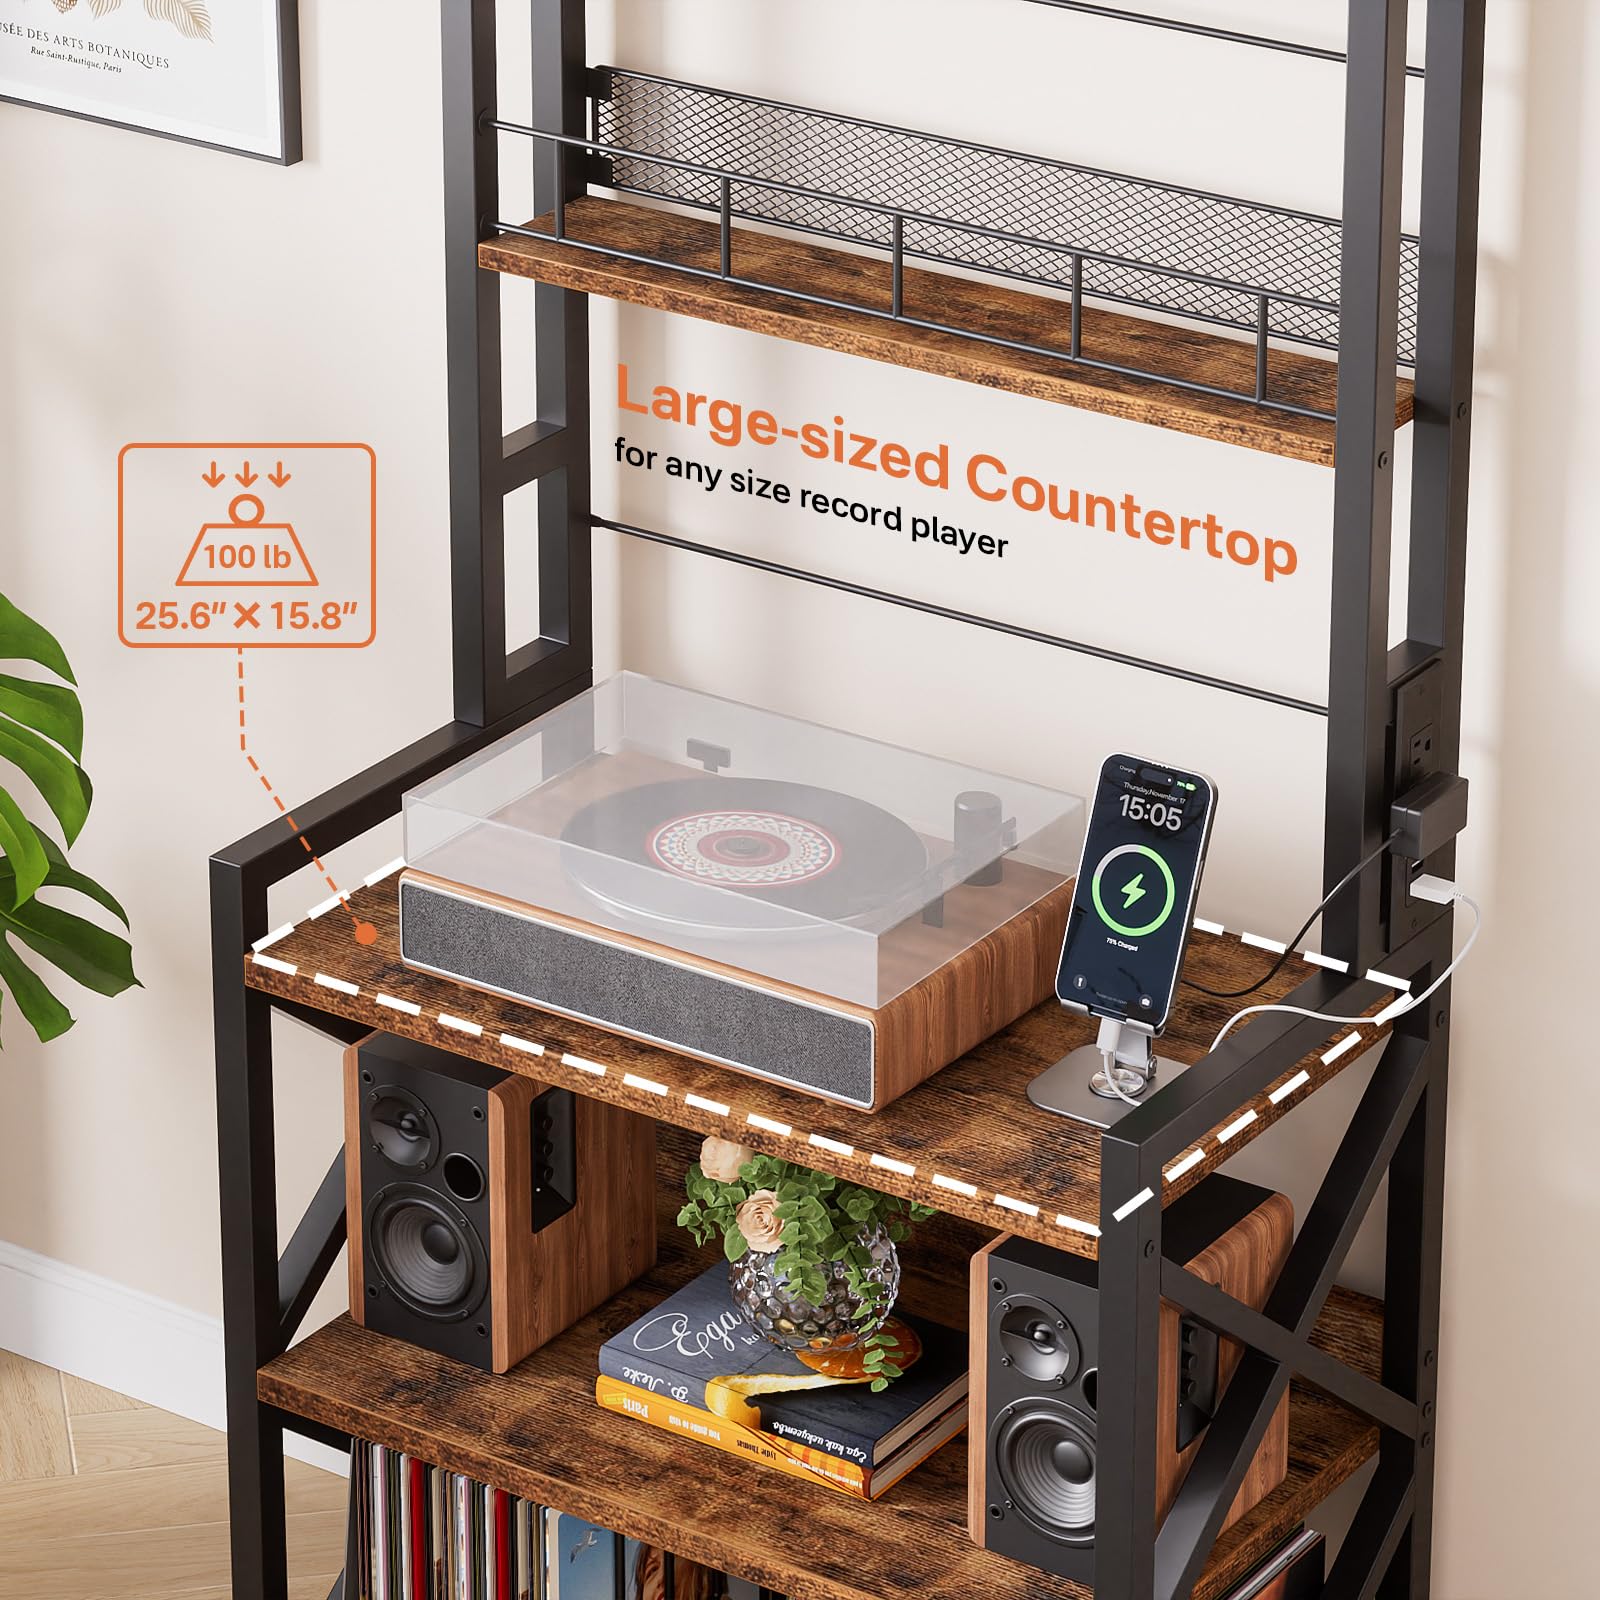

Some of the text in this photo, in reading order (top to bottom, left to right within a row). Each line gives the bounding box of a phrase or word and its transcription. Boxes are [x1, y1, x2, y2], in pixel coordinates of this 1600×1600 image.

[27, 28, 49, 42] DES
[53, 35, 84, 50] ARTS
[88, 41, 169, 69] BOTANIQUES
[30, 46, 122, 73] Rue Saint-Rustique, Paris
[1119, 793, 1183, 831] 15:05
[623, 1397, 648, 1418] Paris
[736, 1439, 760, 1454] Thomas
